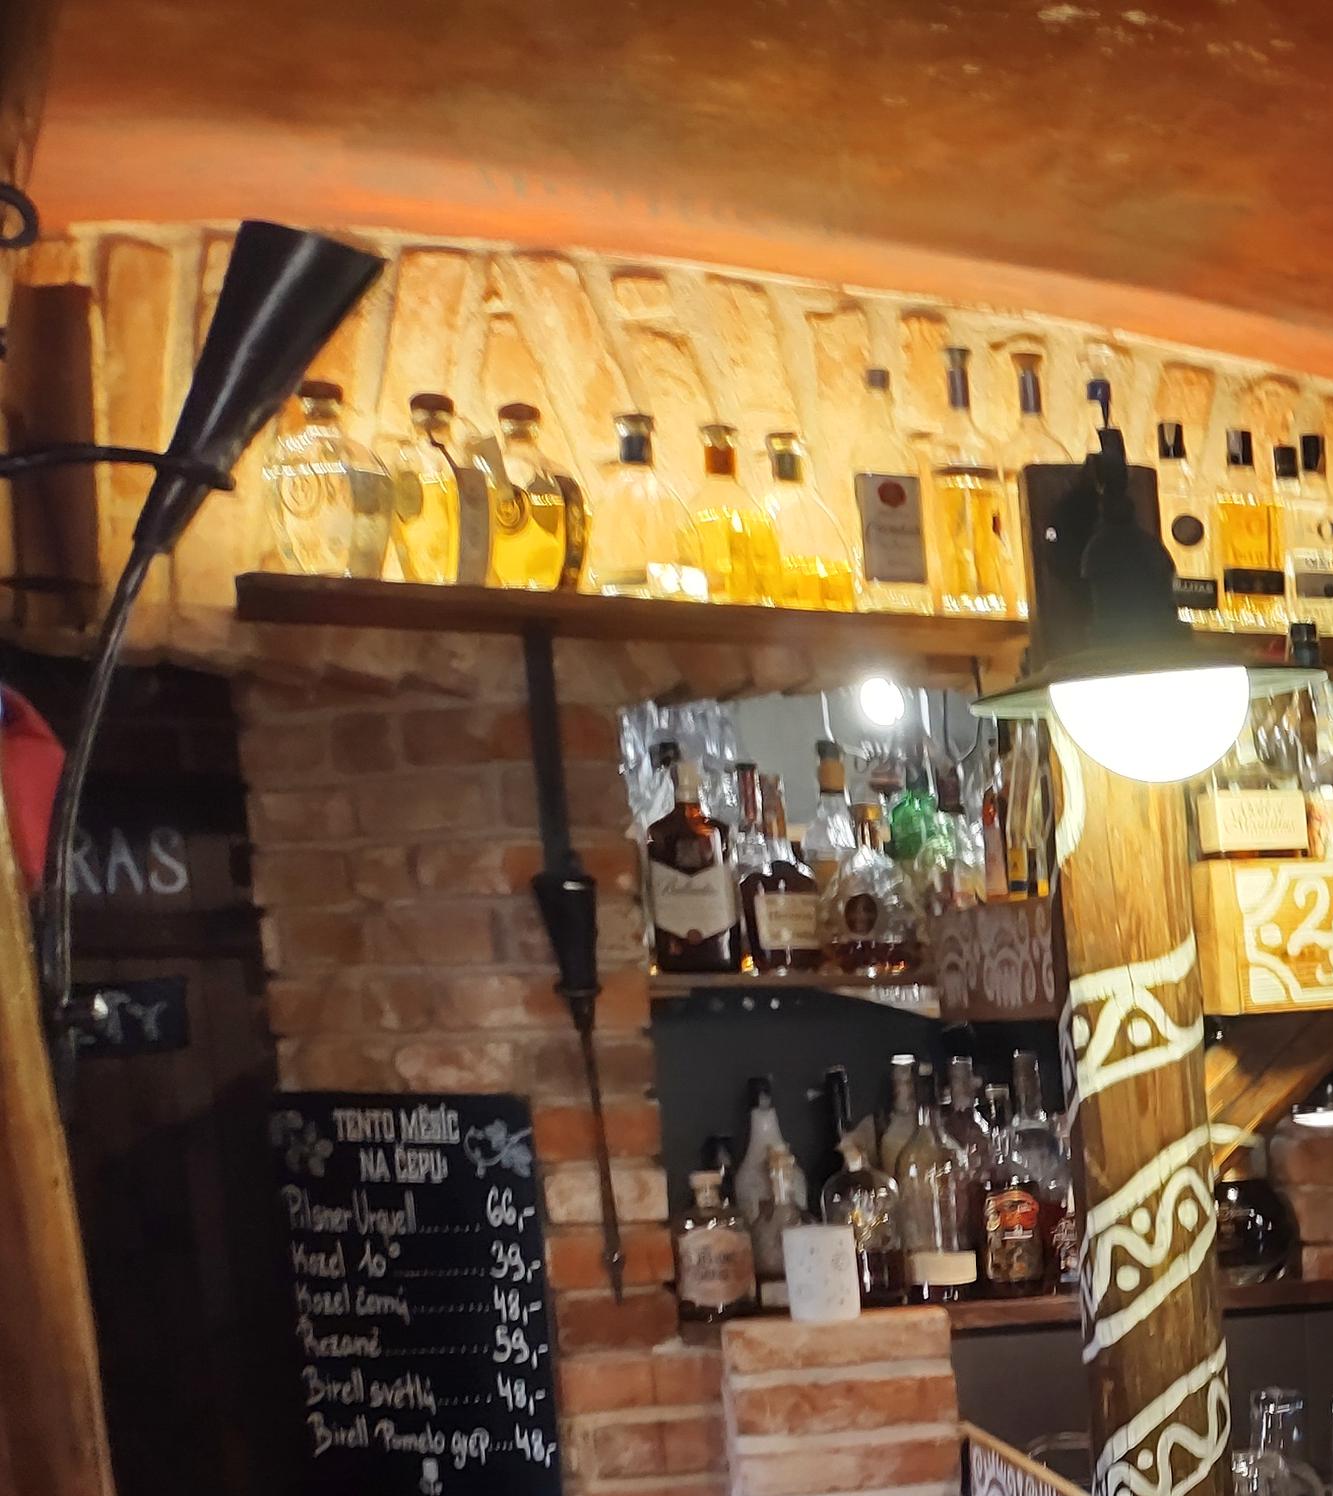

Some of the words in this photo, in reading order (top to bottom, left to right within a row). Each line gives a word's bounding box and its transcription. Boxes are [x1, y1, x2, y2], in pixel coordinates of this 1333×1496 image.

[334, 1108, 394, 1142] TENTO
[400, 1103, 460, 1144] MĚSÍC
[360, 1148, 390, 1182] NA
[303, 1365, 363, 1406] Birell
[307, 1411, 369, 1458] Birell
